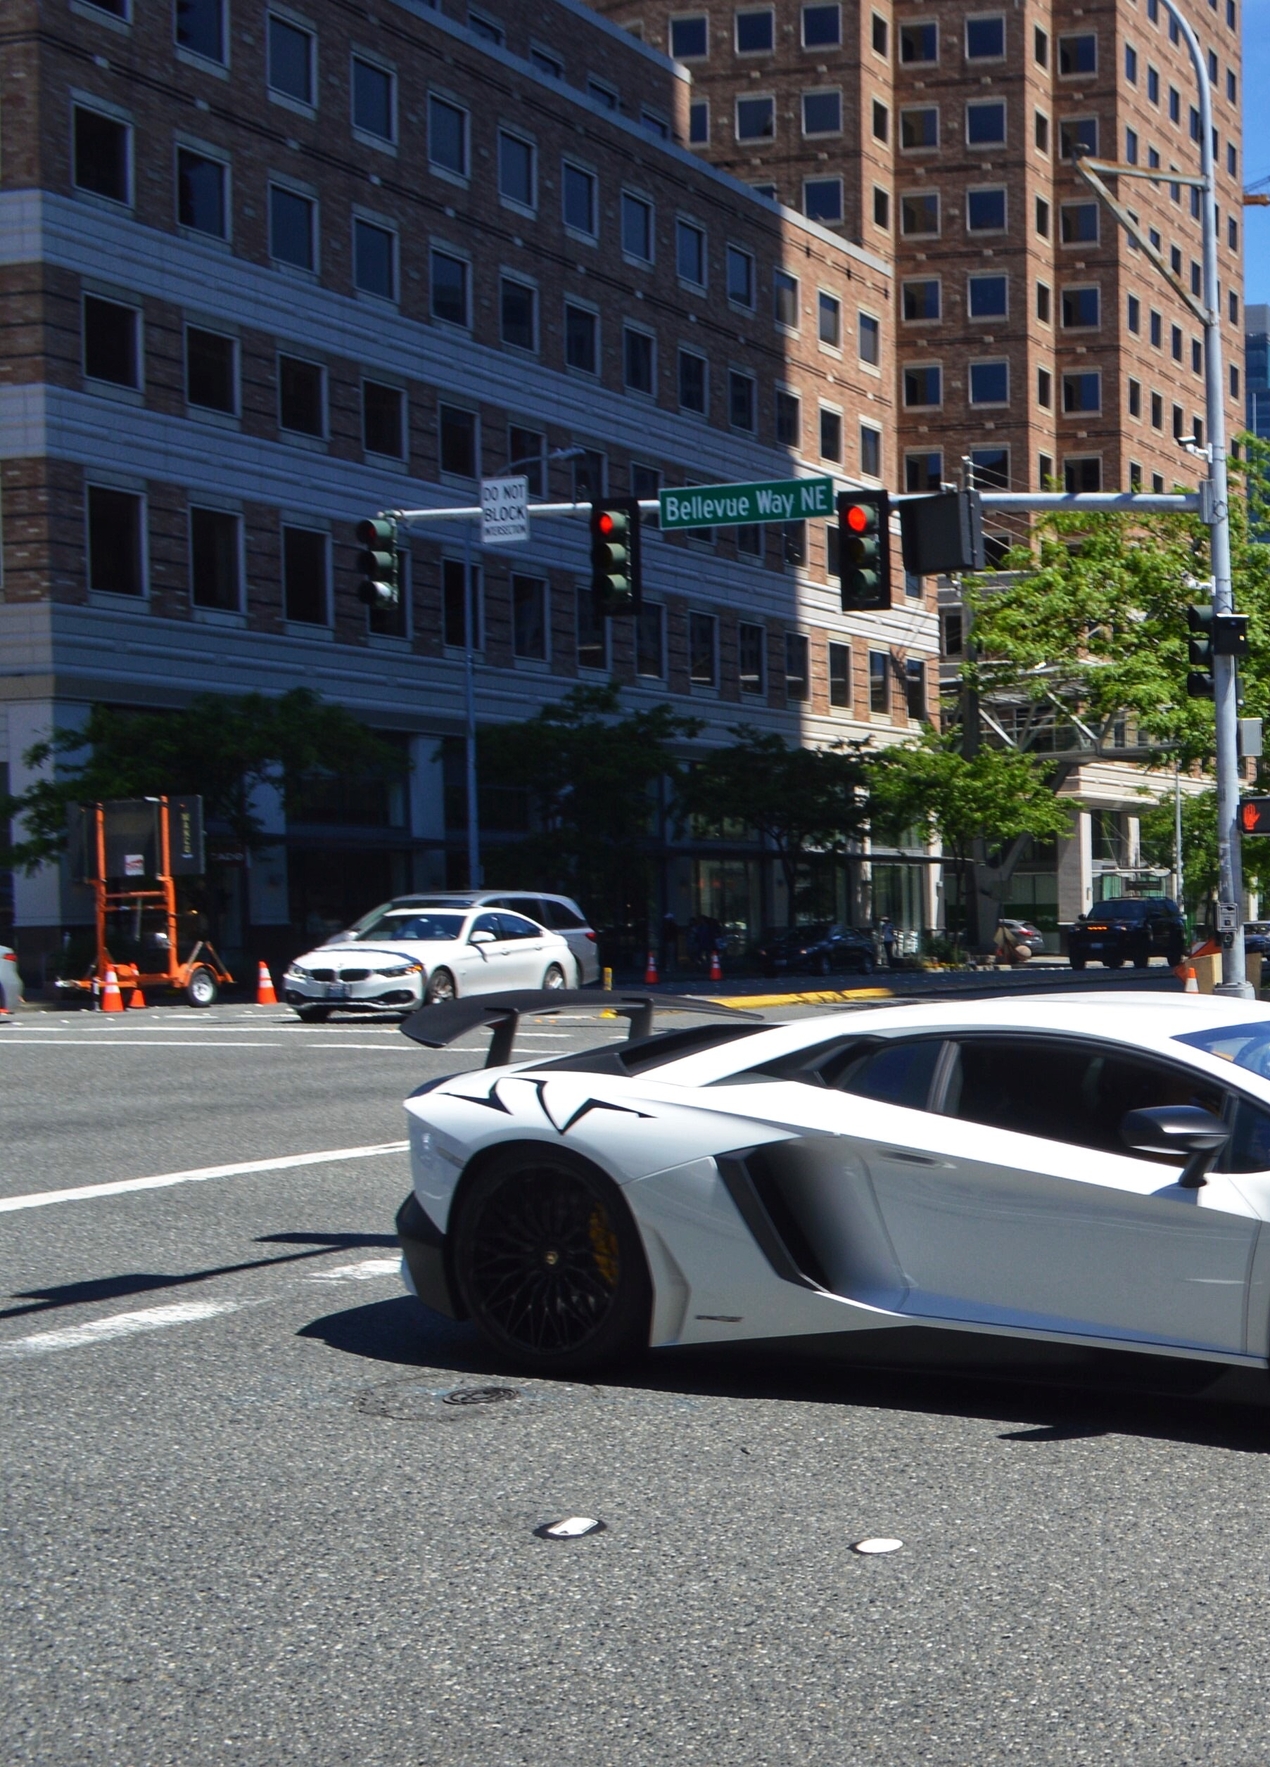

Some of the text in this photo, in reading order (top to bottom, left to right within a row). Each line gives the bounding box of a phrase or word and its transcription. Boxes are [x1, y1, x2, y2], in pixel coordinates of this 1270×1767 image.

[484, 484, 526, 501] DO NOT
[666, 485, 828, 521] Bellevue Way NE
[484, 506, 526, 521] BLOCK
